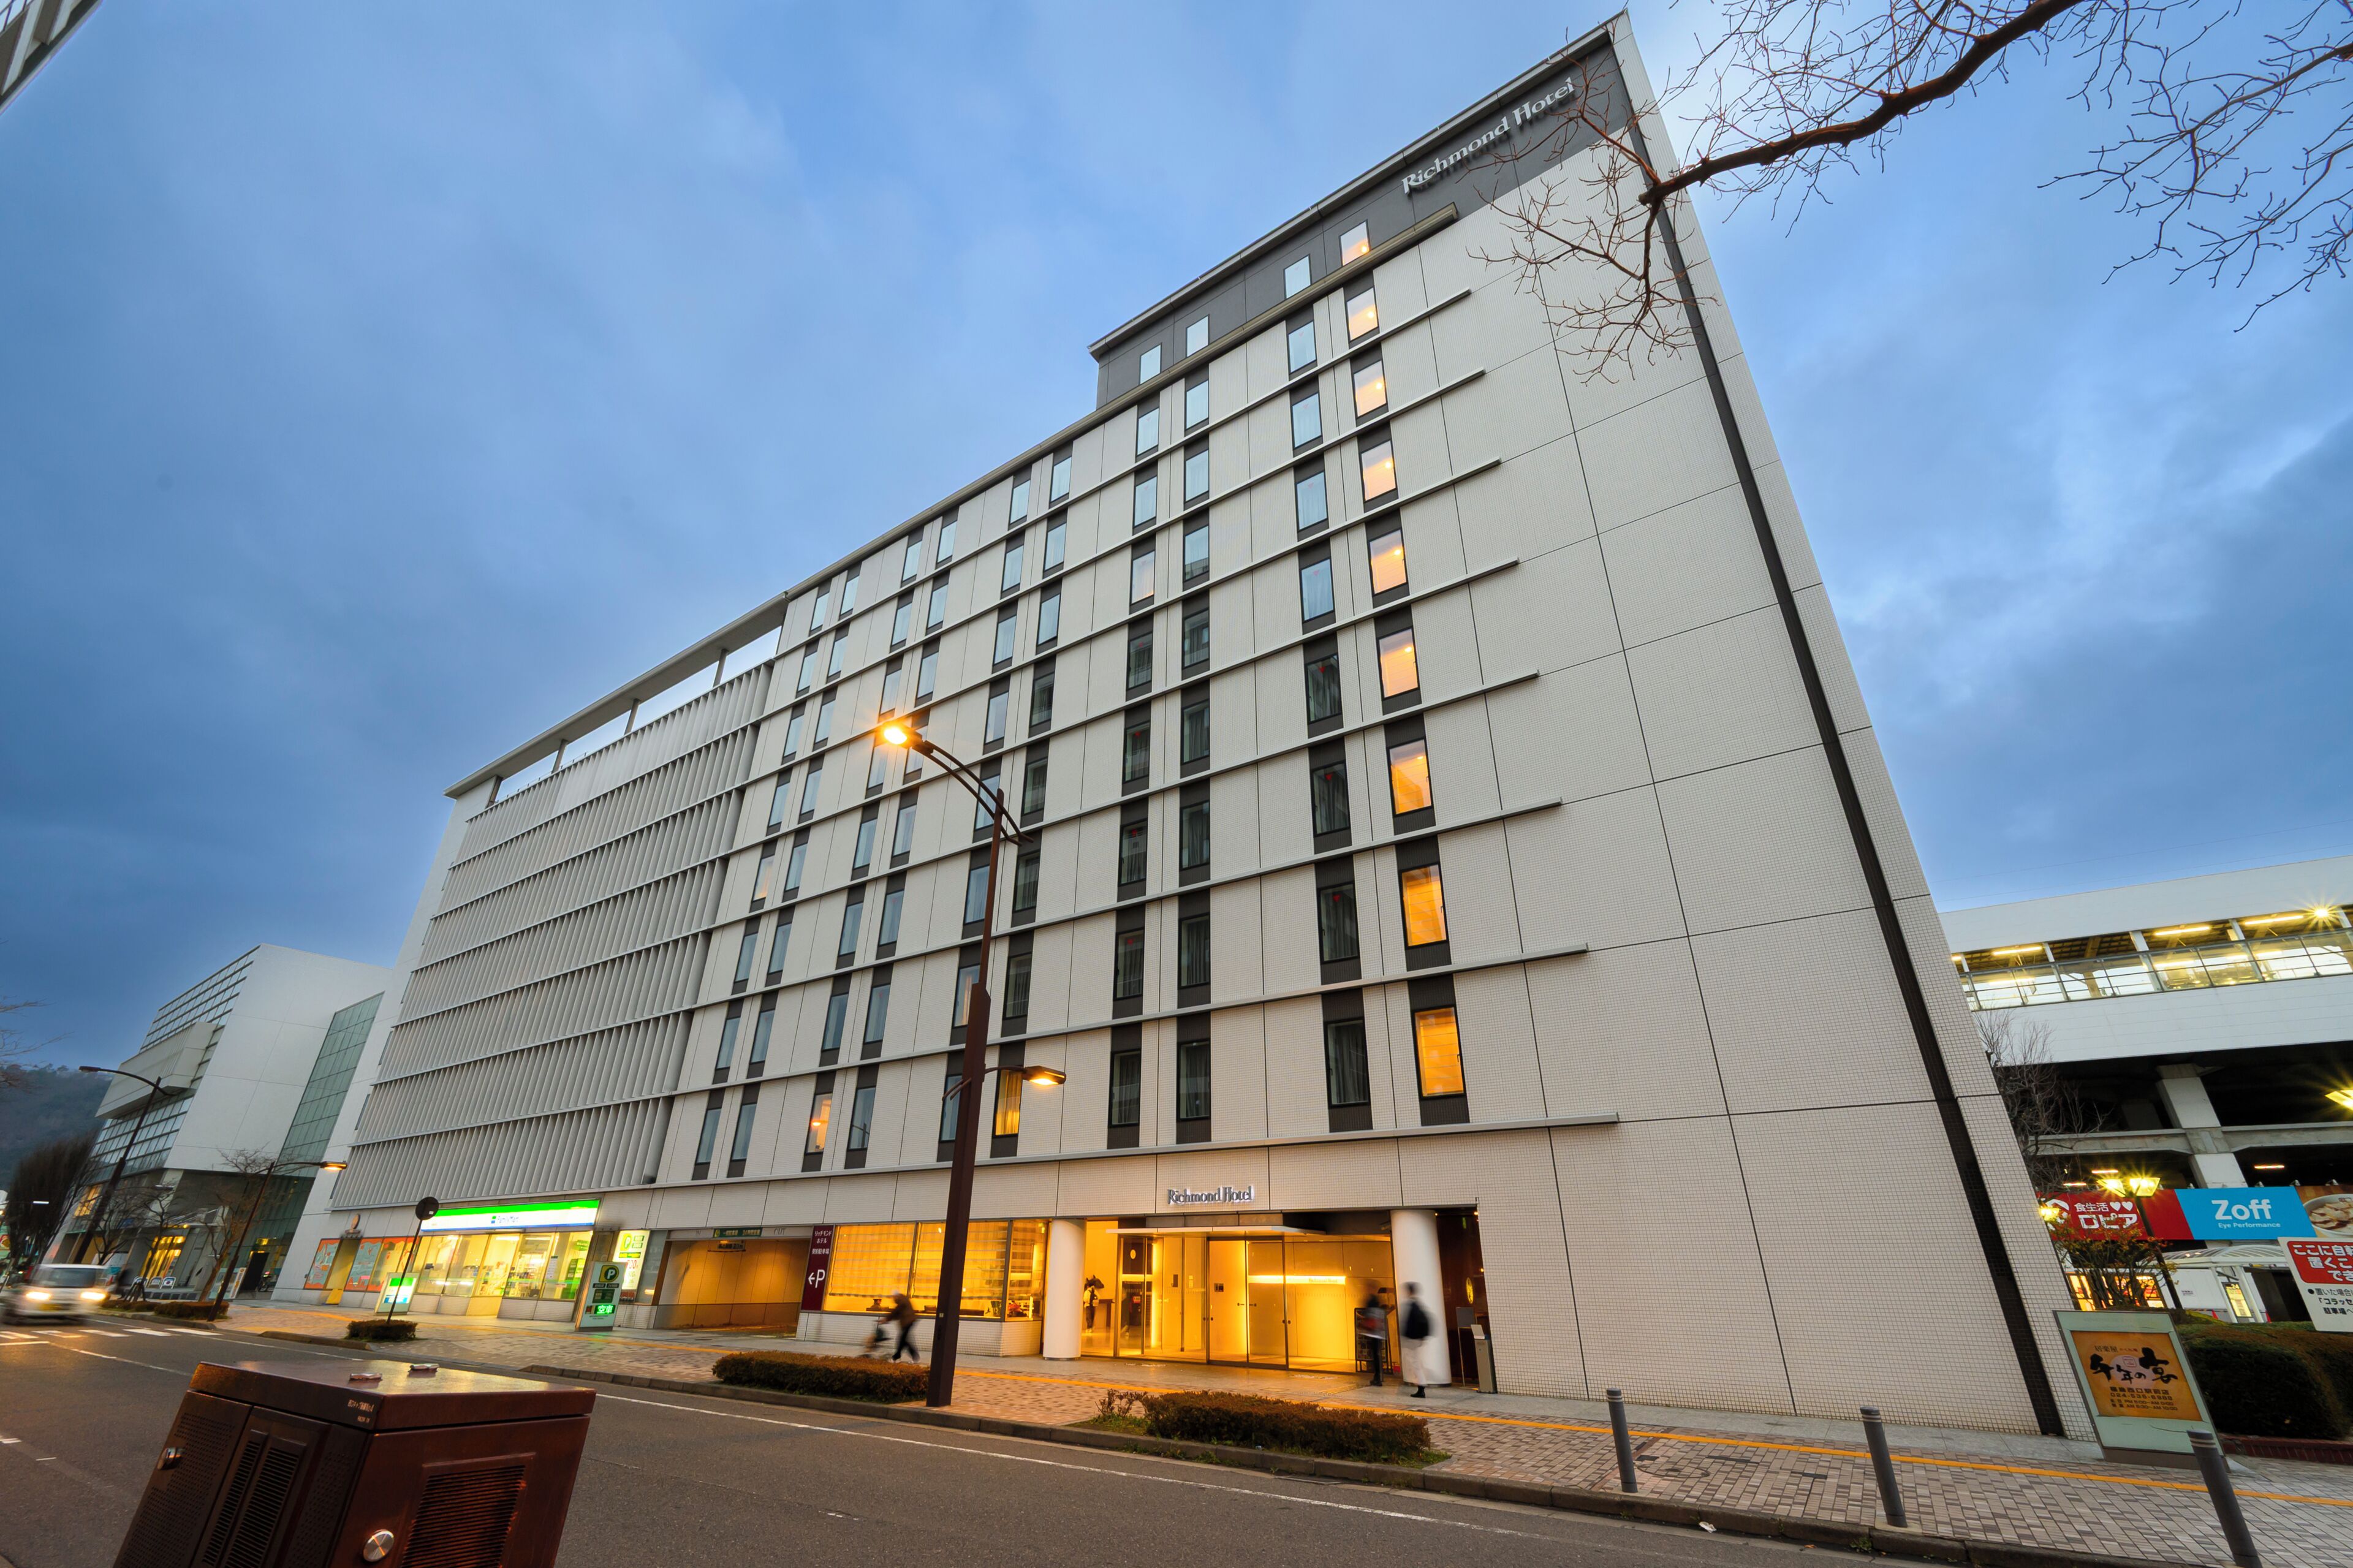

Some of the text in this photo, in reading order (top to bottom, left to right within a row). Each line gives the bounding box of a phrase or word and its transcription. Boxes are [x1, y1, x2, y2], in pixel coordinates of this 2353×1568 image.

[1401, 77, 1575, 194] Richmond Hotel
[1167, 1186, 1253, 1205] Richmond Hotel
[2074, 1202, 2109, 1212] 食生活
[2211, 1199, 2272, 1221] Zoff
[2078, 1213, 2138, 1229] ロピア
[607, 1269, 615, 1279] P
[815, 1269, 825, 1289] P
[596, 1305, 613, 1314] 空車
[2090, 1347, 2178, 1384] 千年の宴
